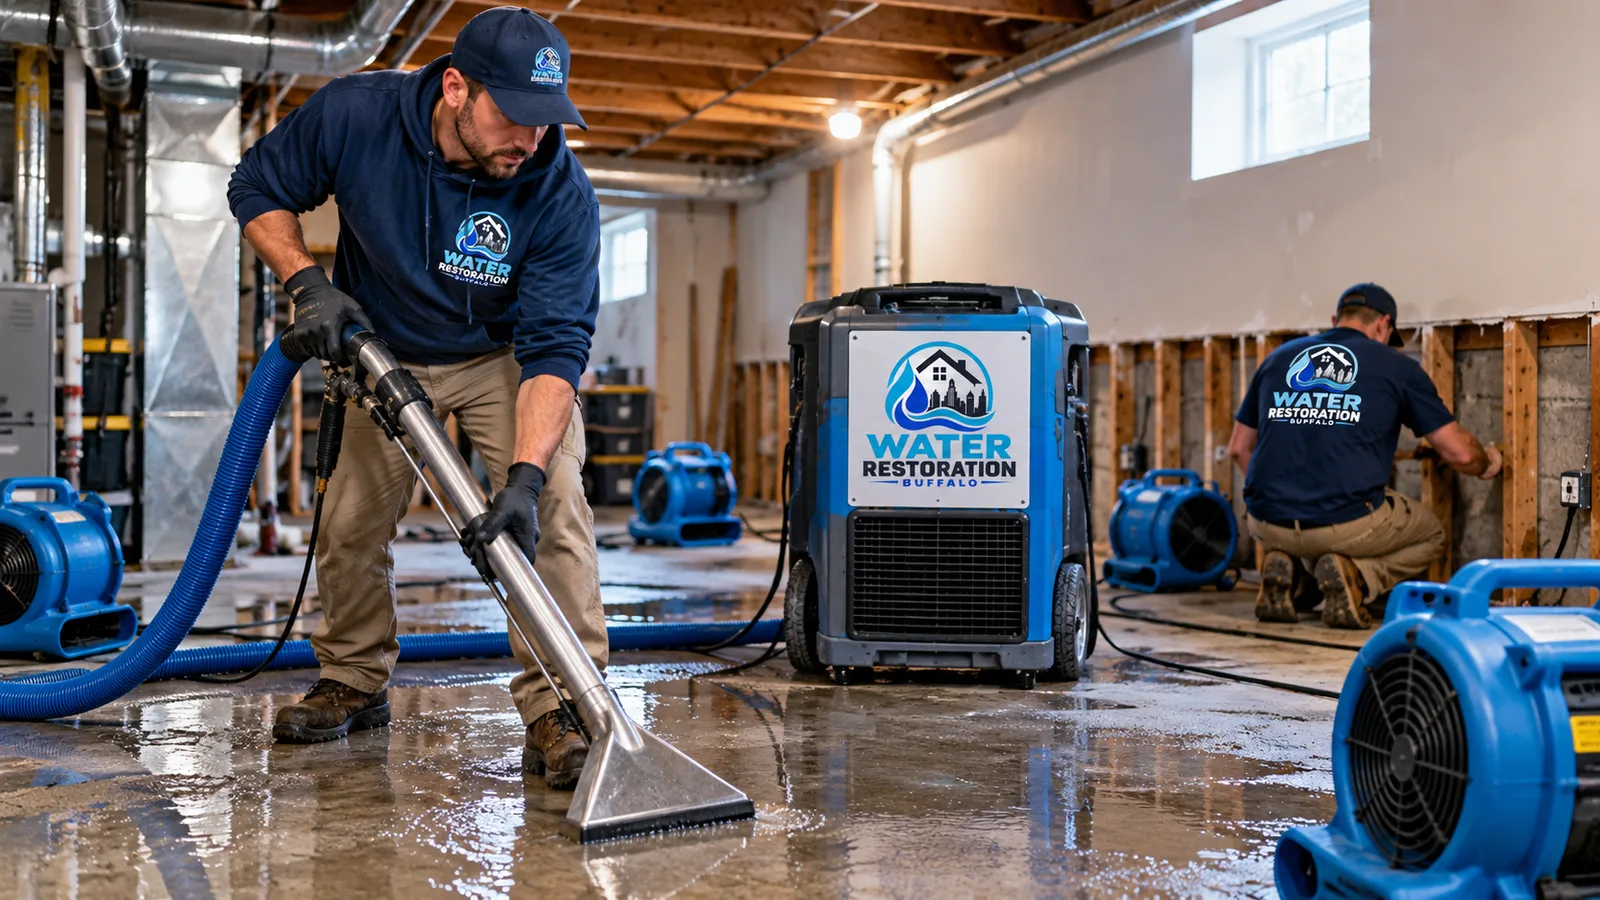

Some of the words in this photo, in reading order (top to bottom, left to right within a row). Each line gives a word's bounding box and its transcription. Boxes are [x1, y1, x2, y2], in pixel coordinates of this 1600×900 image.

[444, 250, 511, 277] WATER
[438, 262, 509, 284] RESTORATION
[1273, 392, 1362, 411] WATER
[1268, 408, 1361, 423] RESTORATION
[1290, 418, 1334, 426] BUFFALO
[865, 433, 1012, 459] WATER
[863, 460, 1016, 477] RESTORATION
[902, 479, 978, 487] BUFFALO
